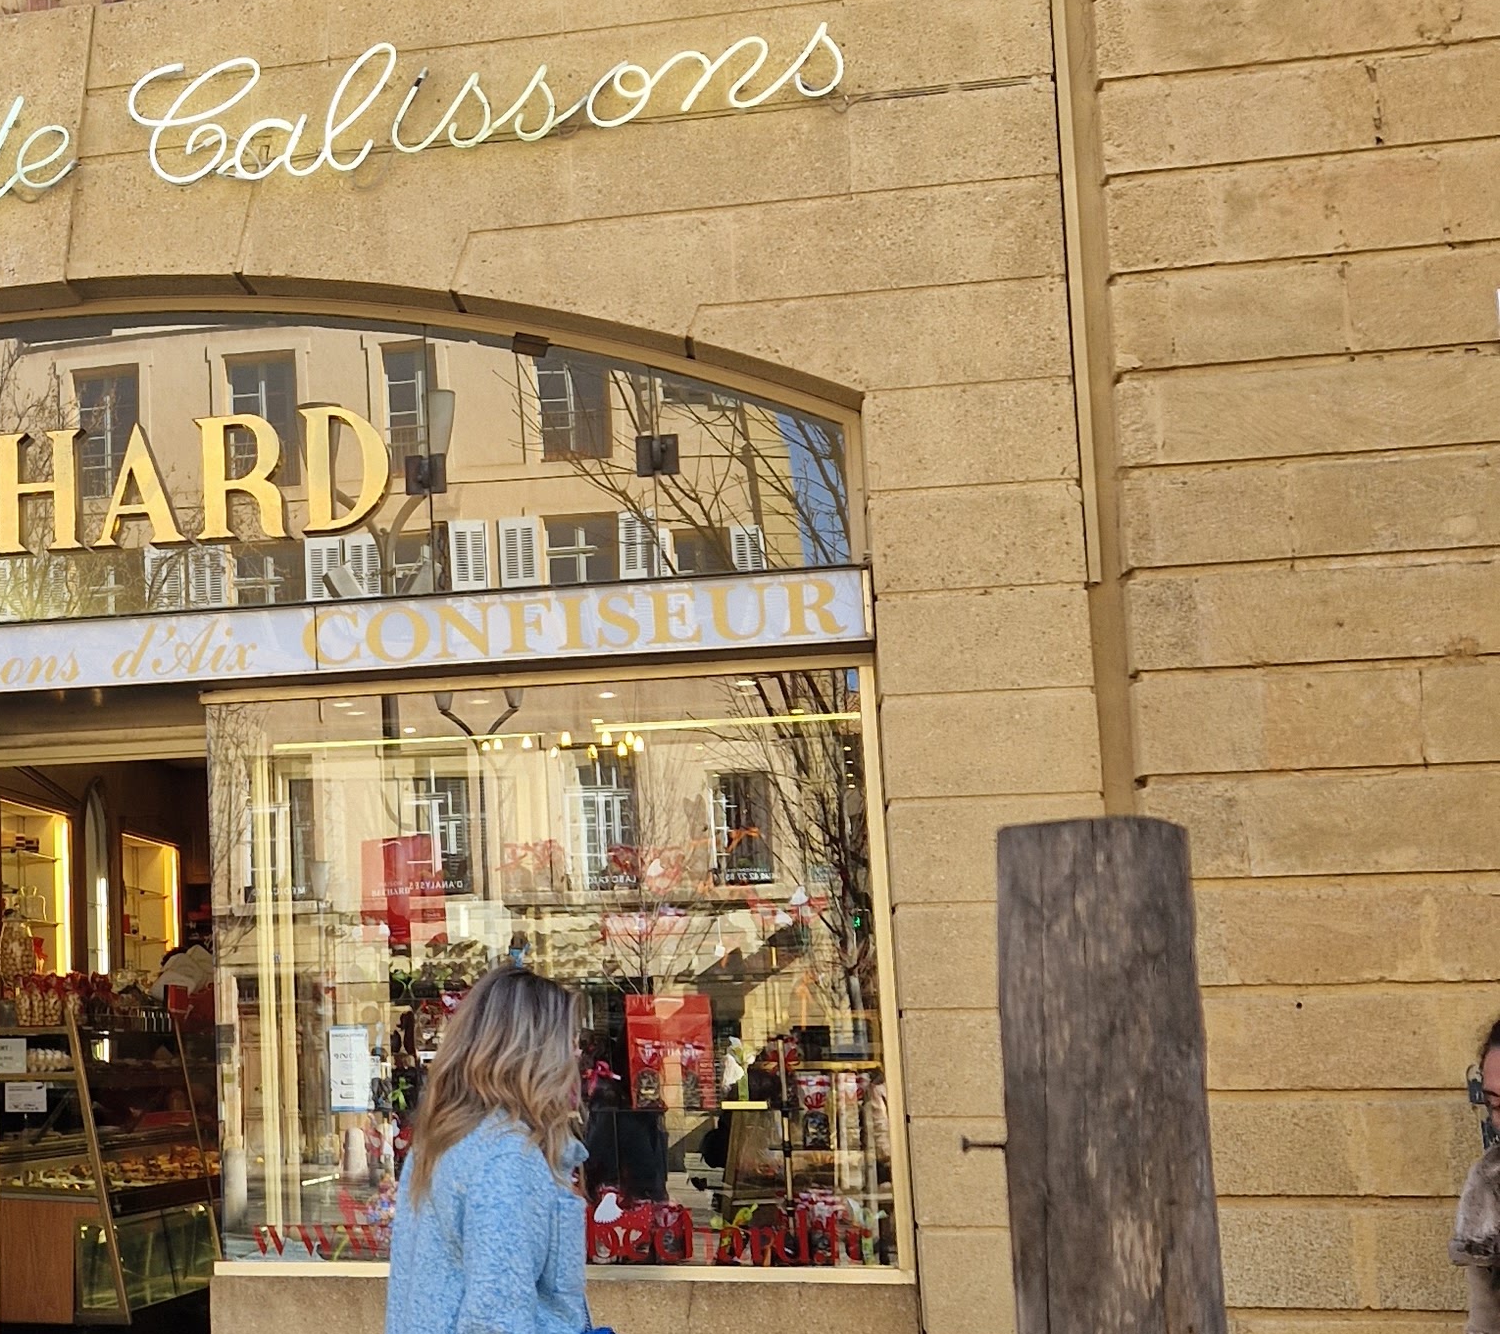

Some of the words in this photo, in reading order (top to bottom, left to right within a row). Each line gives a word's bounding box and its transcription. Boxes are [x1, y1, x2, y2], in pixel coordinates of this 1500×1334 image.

[127, 21, 845, 185] Calissons
[112, 615, 258, 679] d'Aix
[302, 578, 848, 666] CONFISEUR
